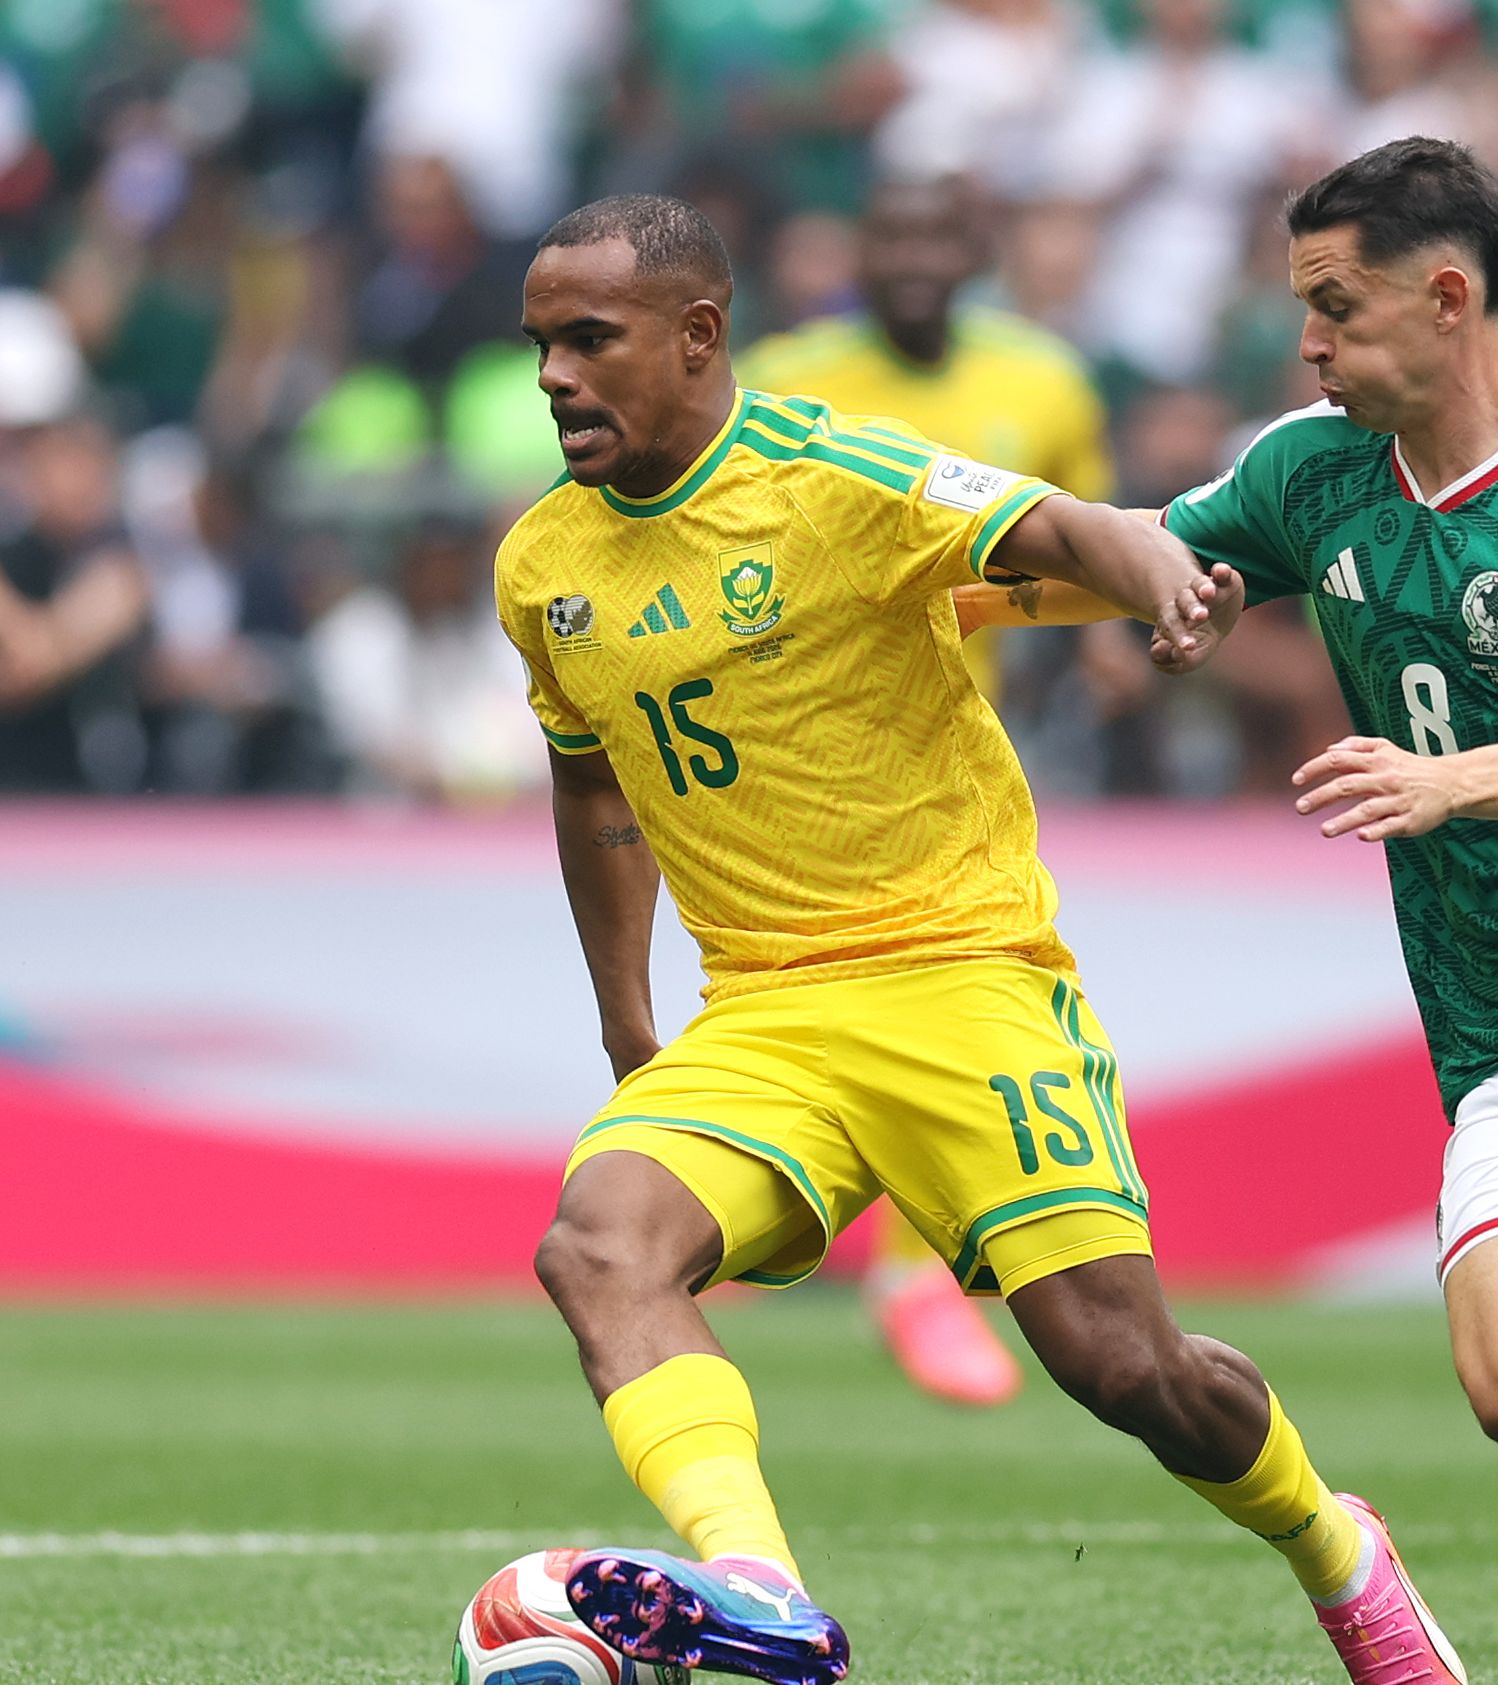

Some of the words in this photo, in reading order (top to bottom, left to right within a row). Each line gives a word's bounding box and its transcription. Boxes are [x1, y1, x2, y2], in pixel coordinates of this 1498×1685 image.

[730, 623, 754, 634] SOUTH
[754, 615, 779, 633] AFRICA
[635, 678, 739, 797] 15
[1401, 663, 1460, 757] 8
[989, 1071, 1094, 1176] 15
